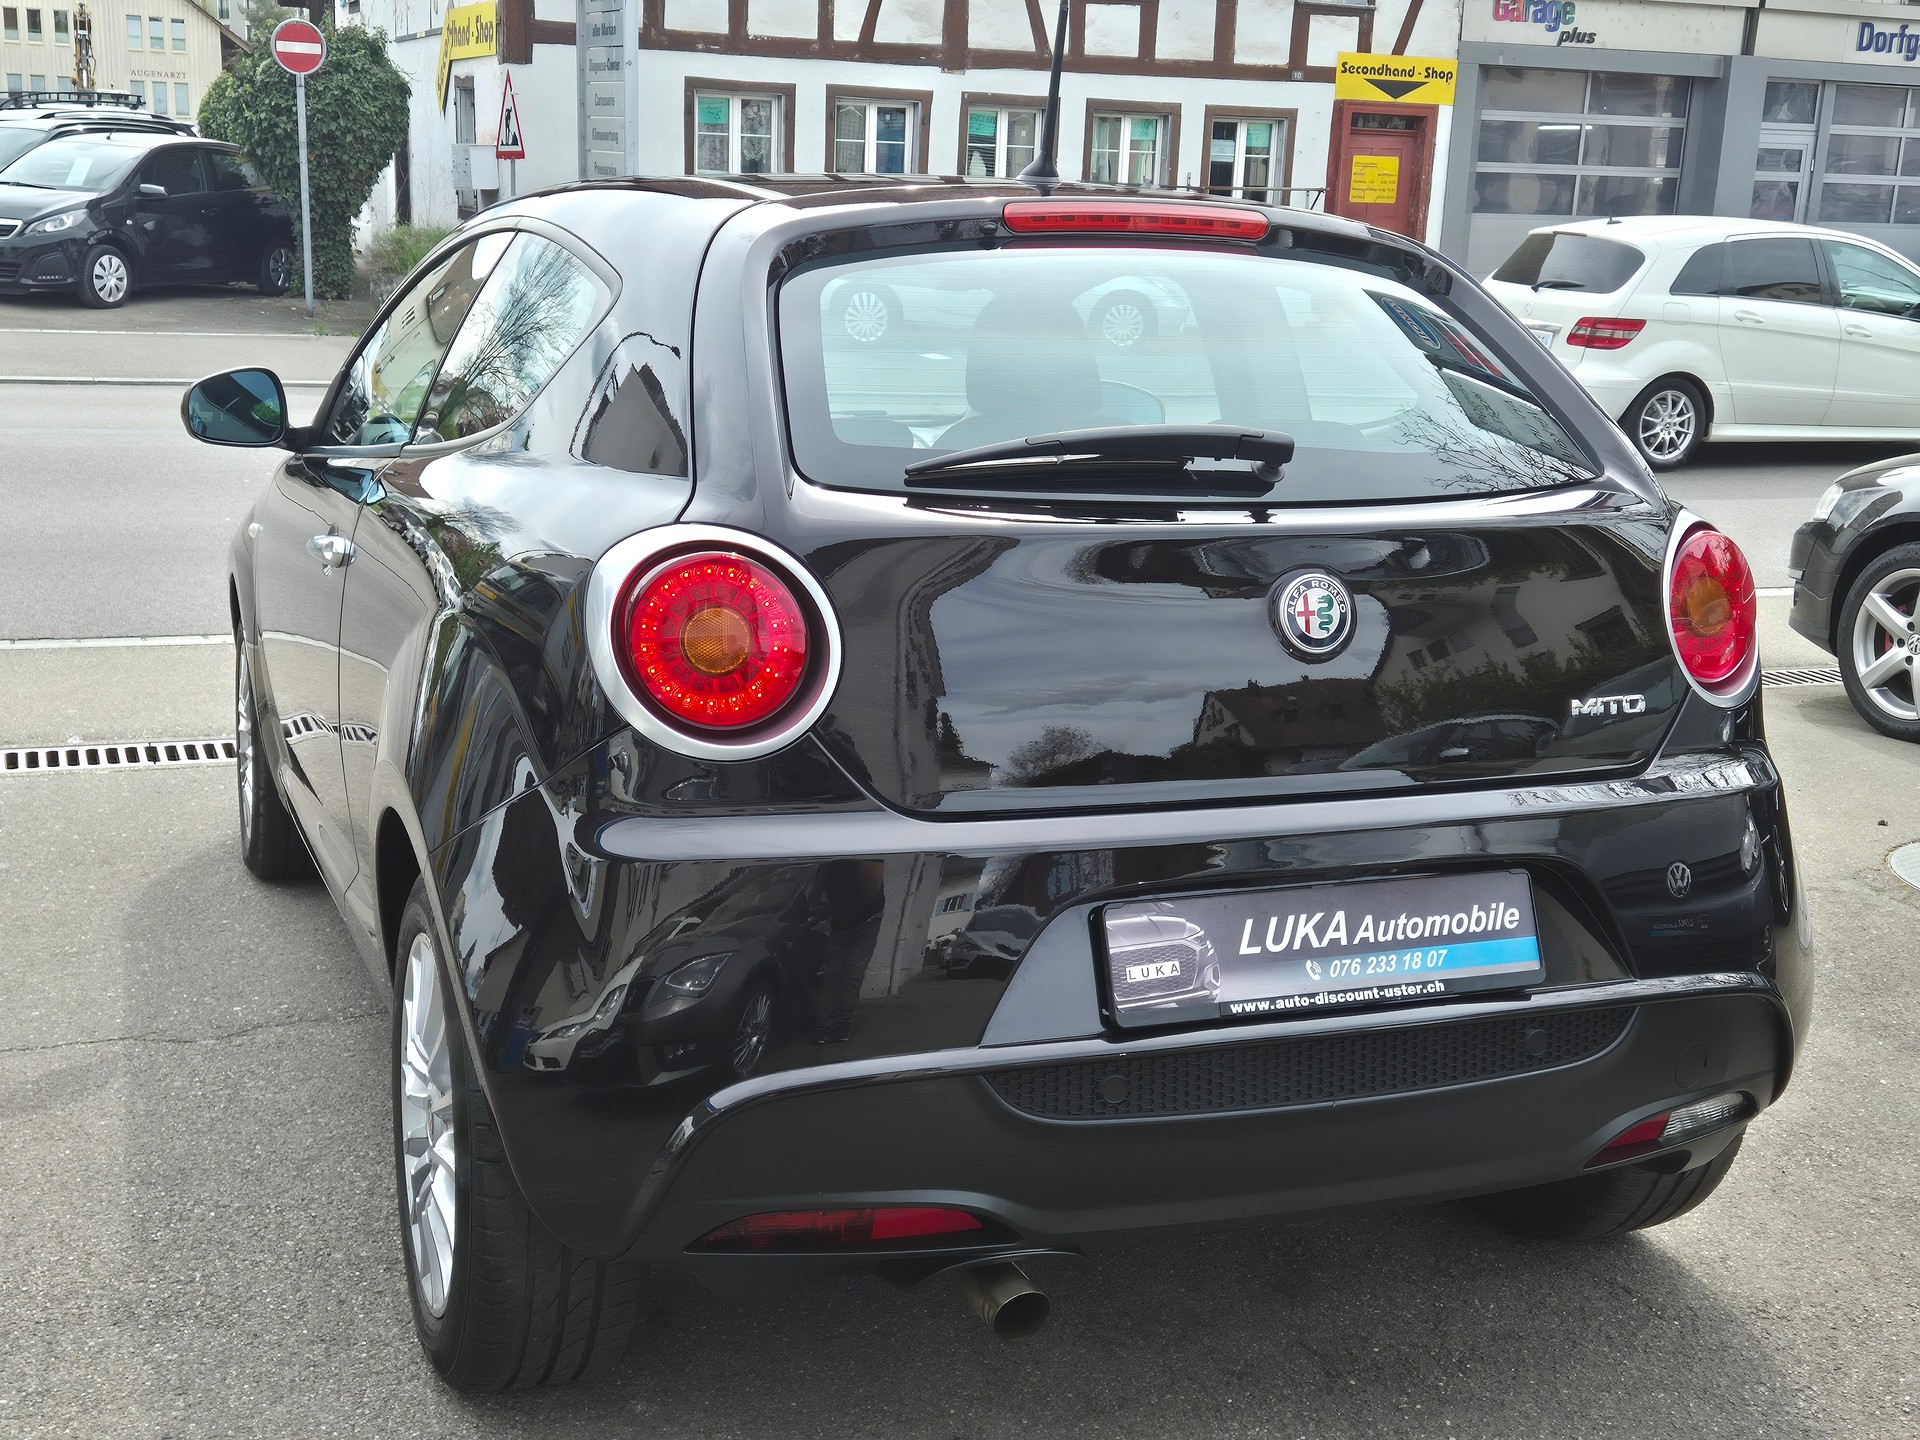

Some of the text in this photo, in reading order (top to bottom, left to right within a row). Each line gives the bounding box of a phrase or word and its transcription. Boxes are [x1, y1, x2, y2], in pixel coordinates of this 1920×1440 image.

[1492, 0, 1576, 33] Garage
[475, 14, 494, 51] Shop
[1556, 26, 1597, 47] plus
[1856, 21, 1920, 62] Dorfg
[130, 69, 187, 80] AUGENARZT
[1340, 61, 1416, 78] Secondhand
[1423, 66, 1454, 83] Shop
[1287, 580, 1346, 615] ALFA ROMEO
[1571, 694, 1647, 717] MITO
[1238, 901, 1520, 956] LUKA Automobile
[1128, 963, 1180, 980] LUKA
[1329, 949, 1449, 978] 076 233 18 07
[1229, 980, 1445, 1014] www.auto-discount-uster.ch
